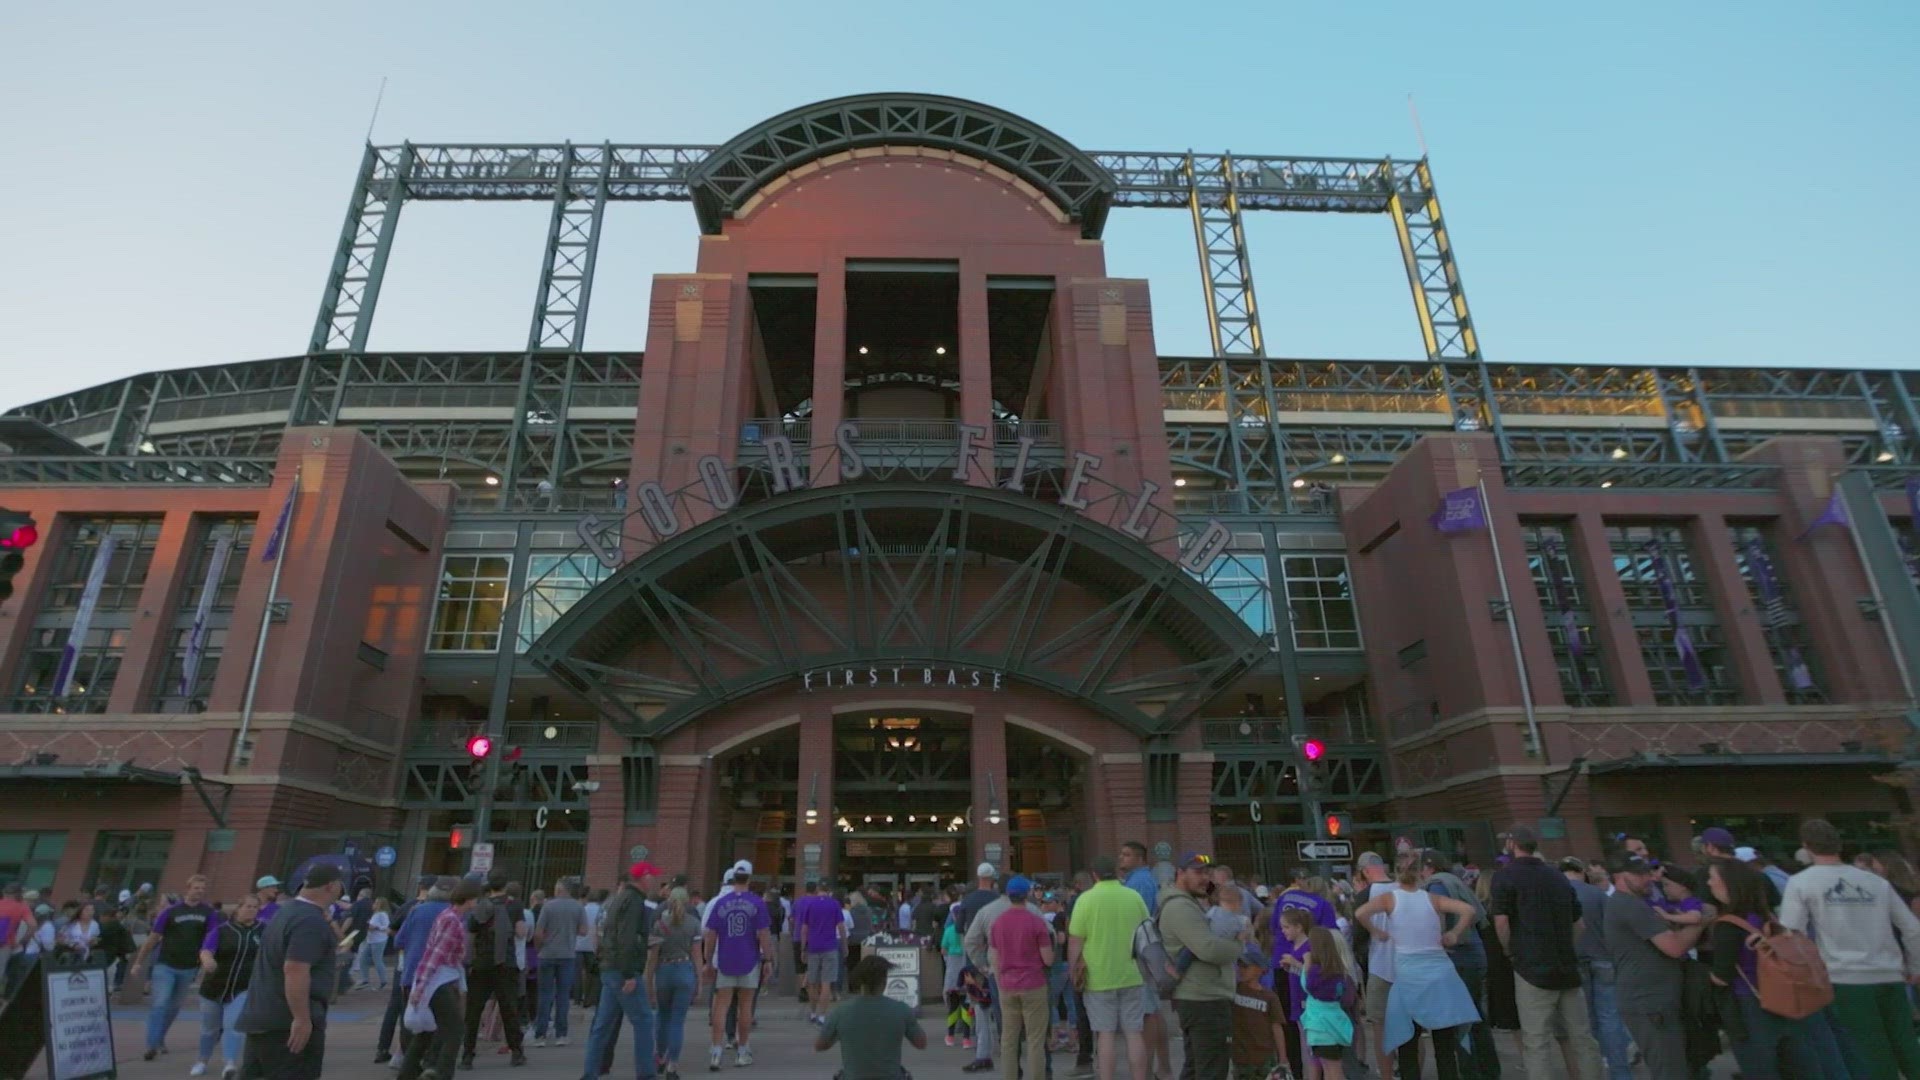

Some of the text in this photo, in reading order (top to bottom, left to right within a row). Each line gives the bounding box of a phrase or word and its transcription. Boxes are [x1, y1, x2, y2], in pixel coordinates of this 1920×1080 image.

[576, 423, 1232, 574] COORS FIELD
[804, 668, 1001, 689] FIRST BASE
[536, 805, 548, 829] C
[1250, 800, 1261, 822] C
[728, 911, 747, 937] 19
